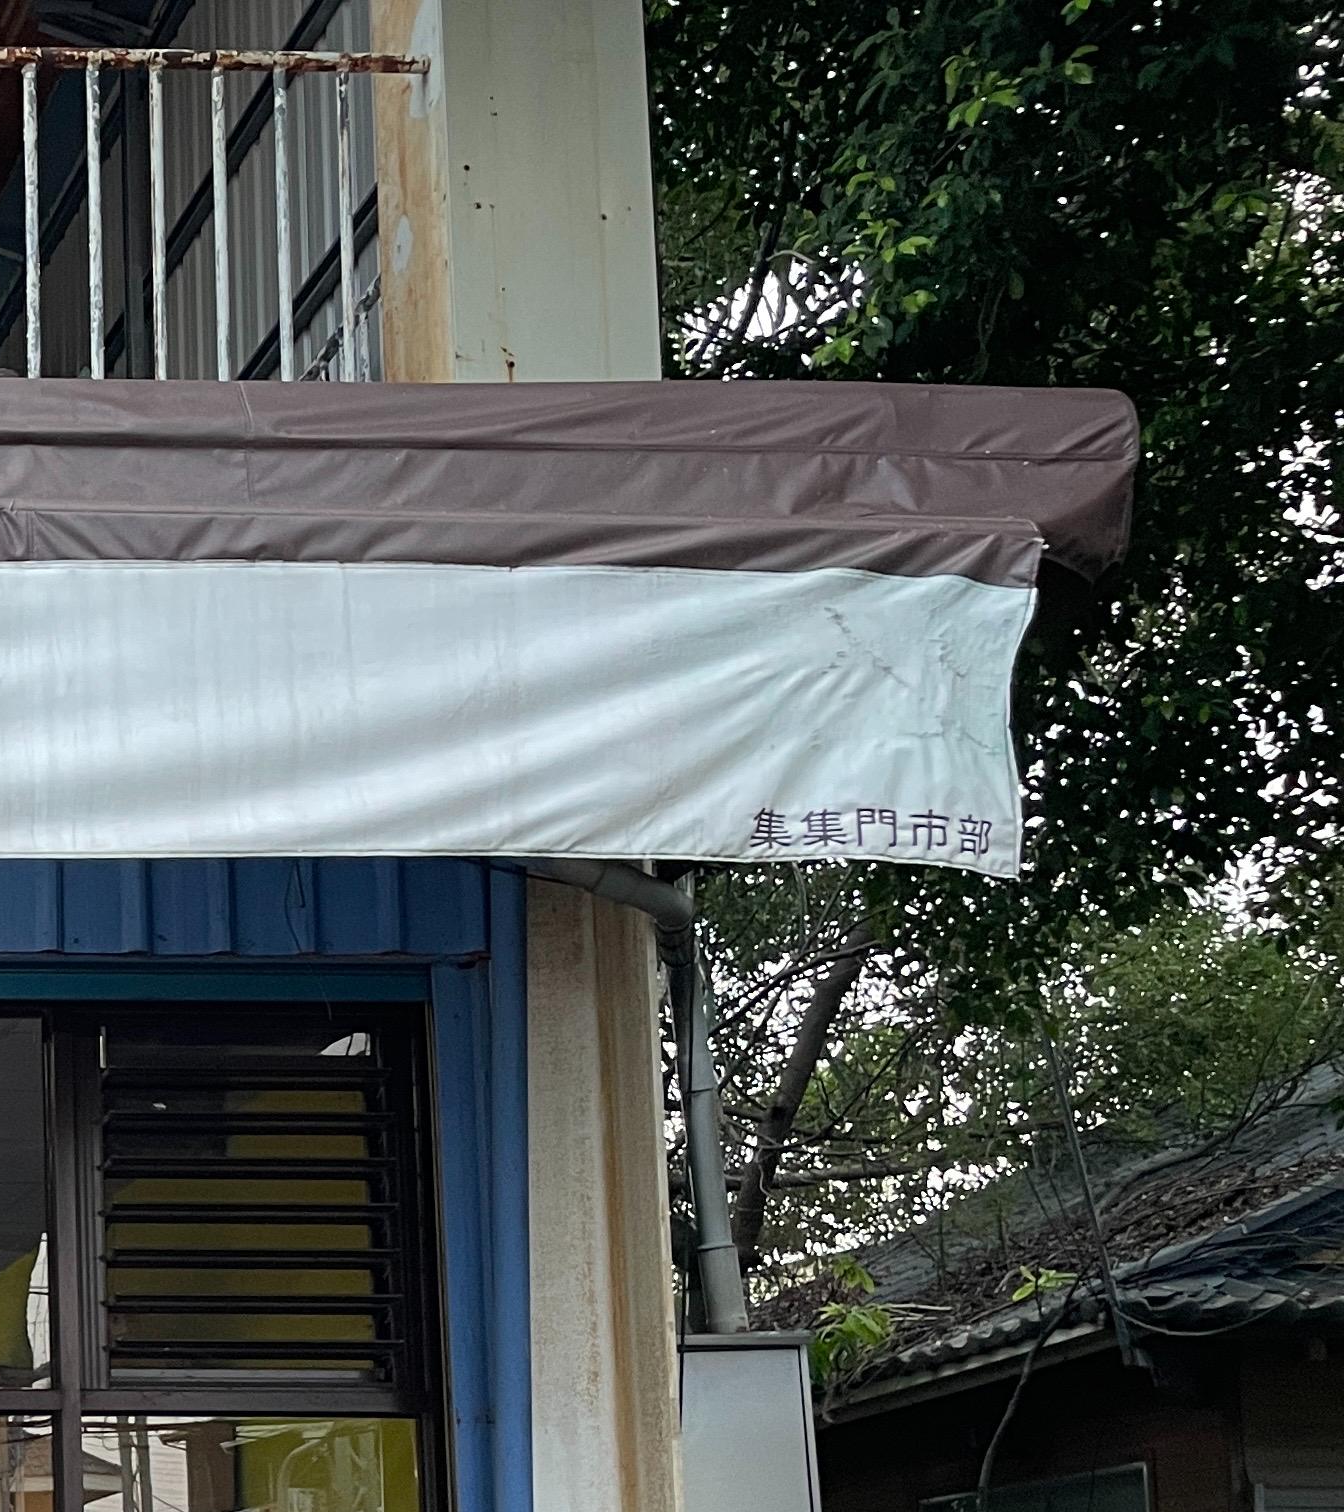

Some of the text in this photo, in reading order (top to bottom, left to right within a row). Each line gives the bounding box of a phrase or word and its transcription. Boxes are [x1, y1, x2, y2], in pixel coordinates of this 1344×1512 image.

[750, 807, 993, 857] 集集門市部
